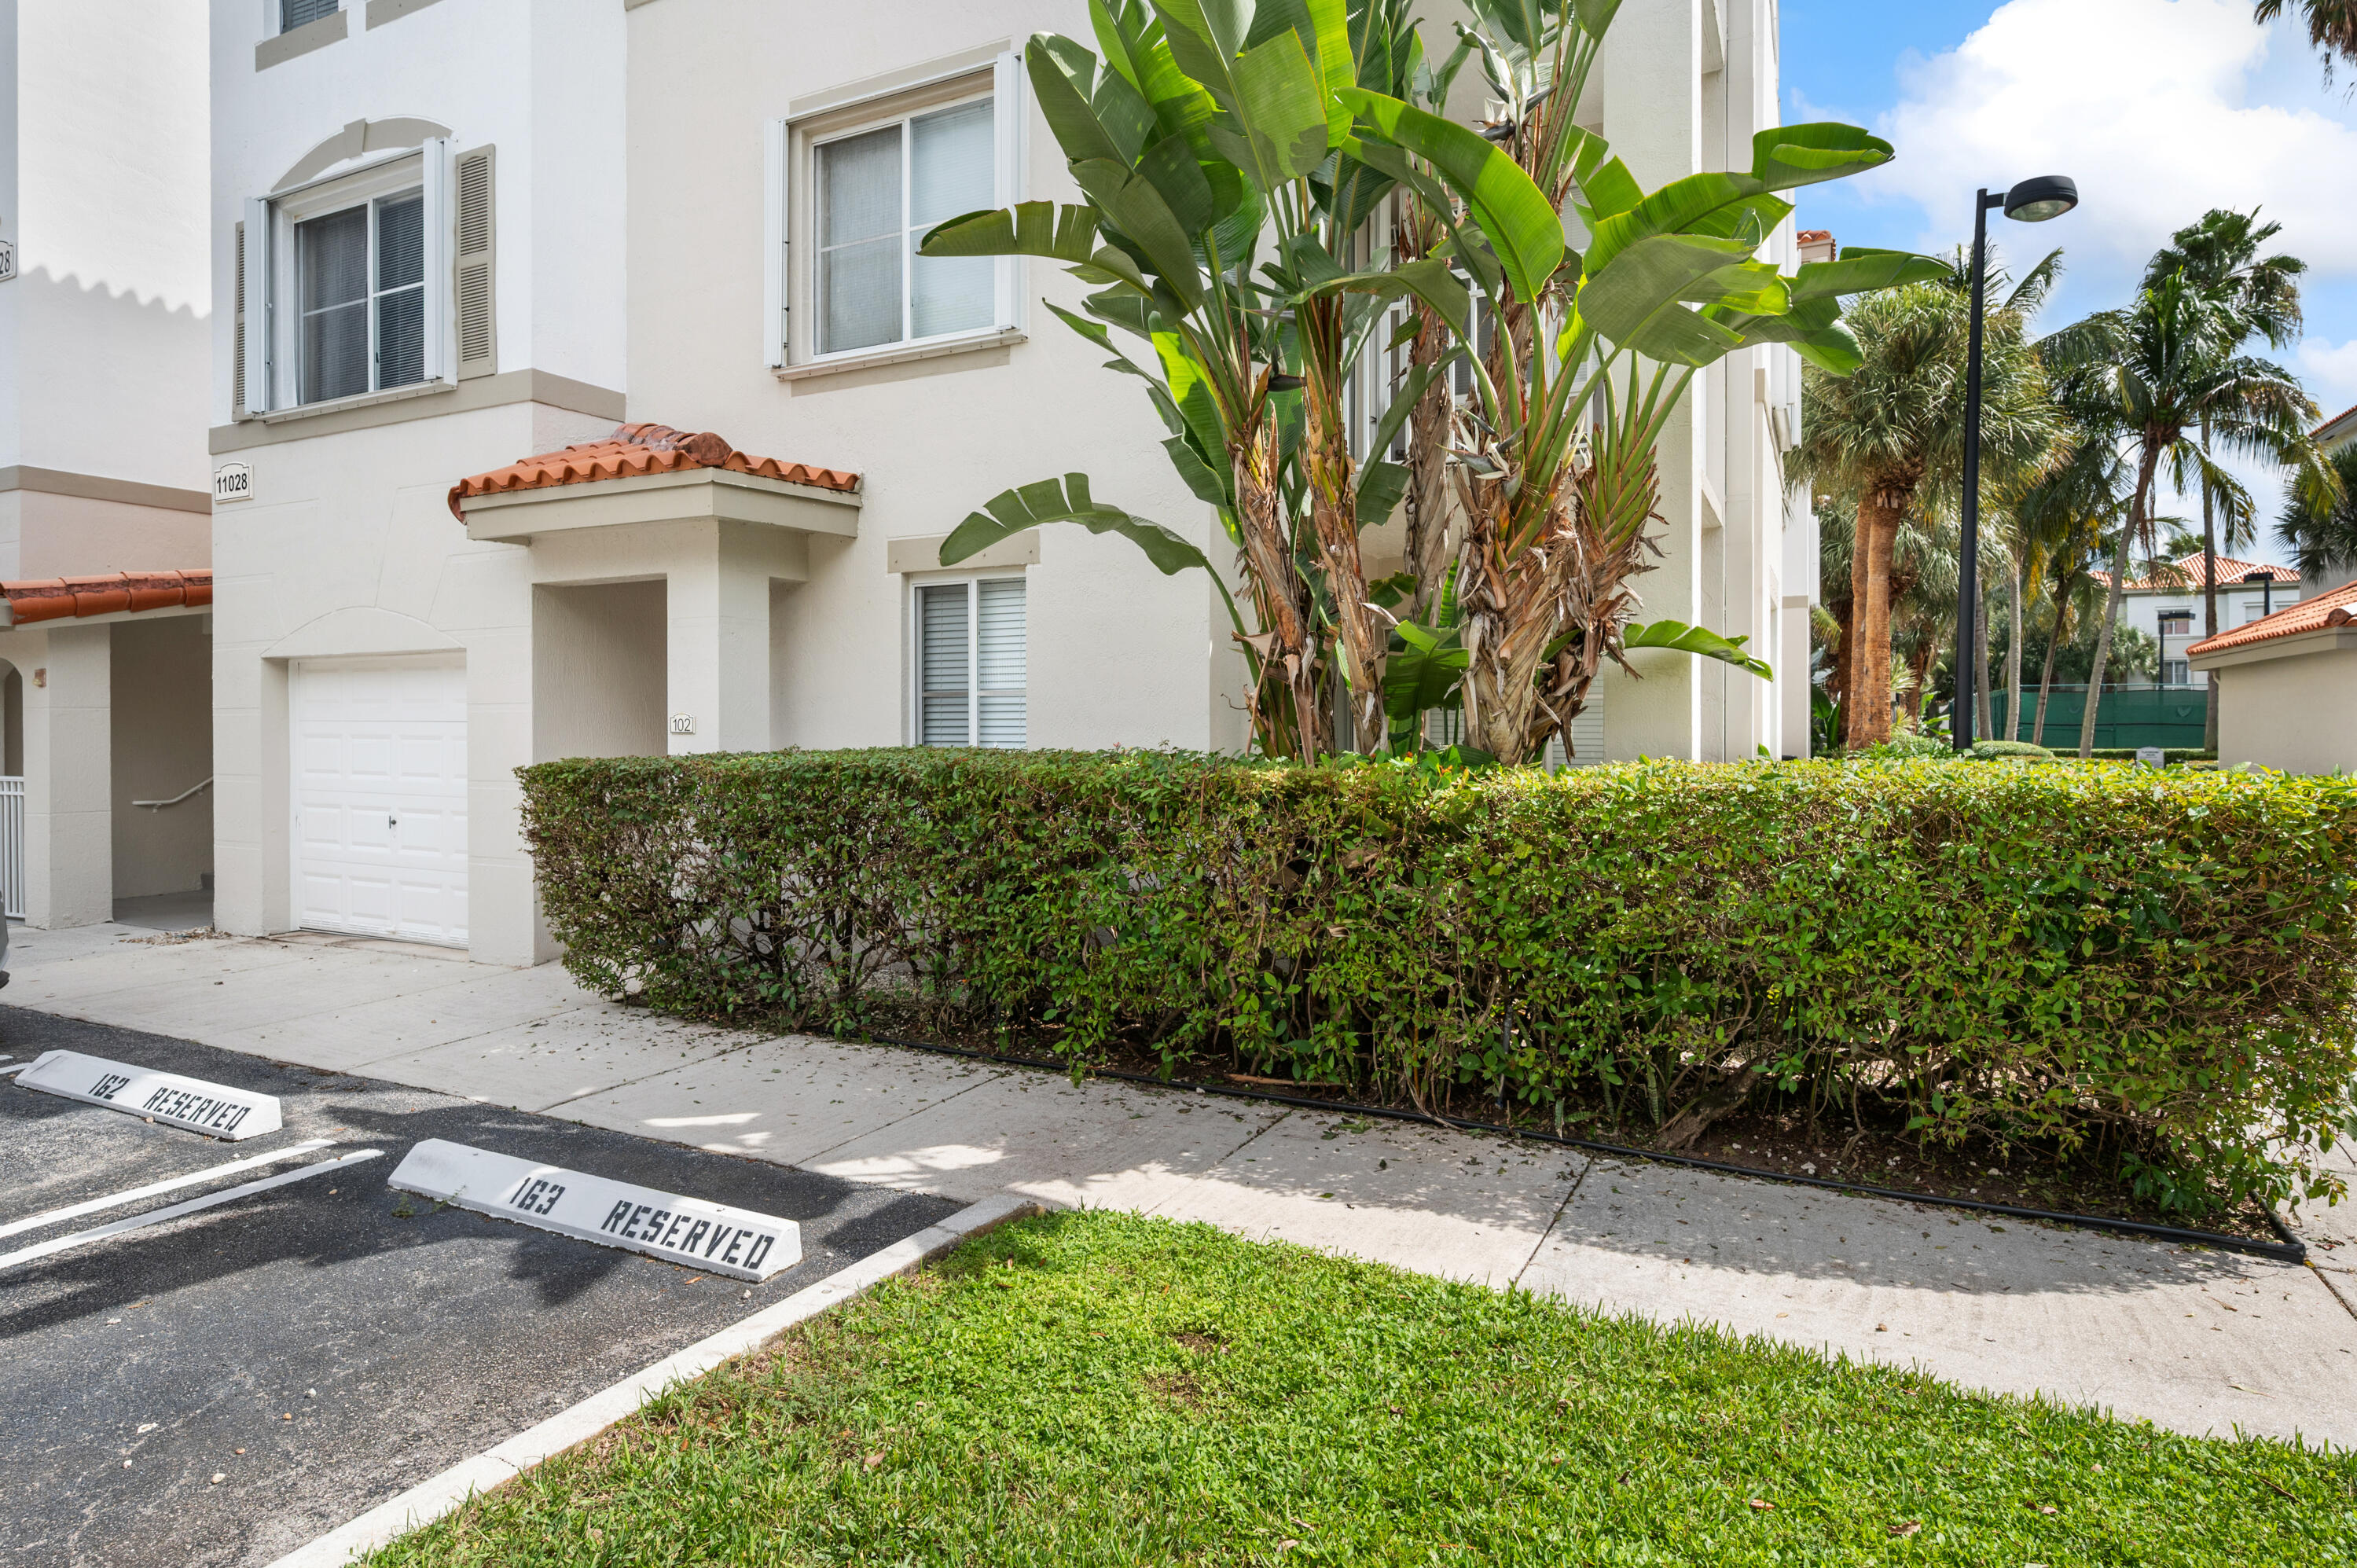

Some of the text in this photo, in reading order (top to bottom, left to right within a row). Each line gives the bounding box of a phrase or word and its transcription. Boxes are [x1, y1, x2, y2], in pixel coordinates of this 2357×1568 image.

[217, 473, 248, 494] 11028
[673, 718, 691, 732] 102
[88, 1073, 251, 1132] 162 RESERVED
[509, 1177, 775, 1270] 163 RESERVED
